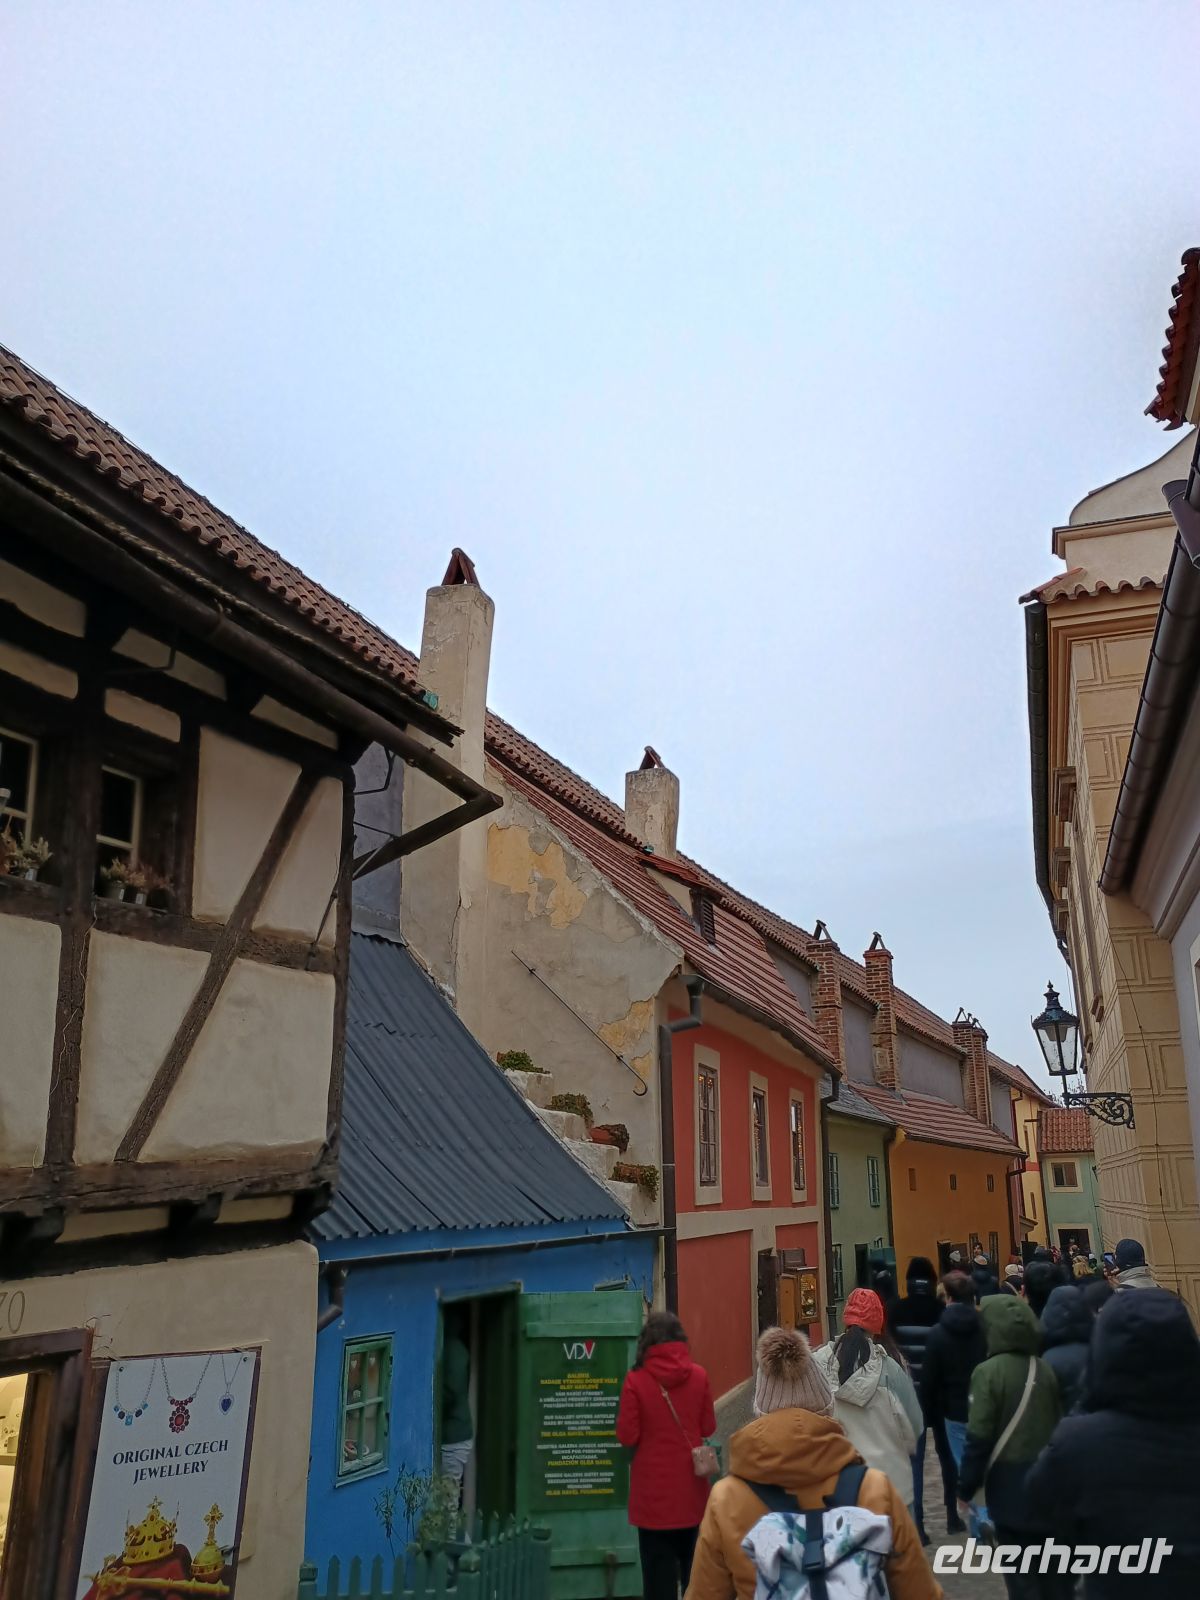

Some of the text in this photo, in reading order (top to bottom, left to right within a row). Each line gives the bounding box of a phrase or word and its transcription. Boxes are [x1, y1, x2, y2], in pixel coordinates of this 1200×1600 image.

[563, 1342, 596, 1360] VDV
[112, 1440, 229, 1465] ORIGINAL CZECH
[133, 1460, 209, 1485] JEWELLERY
